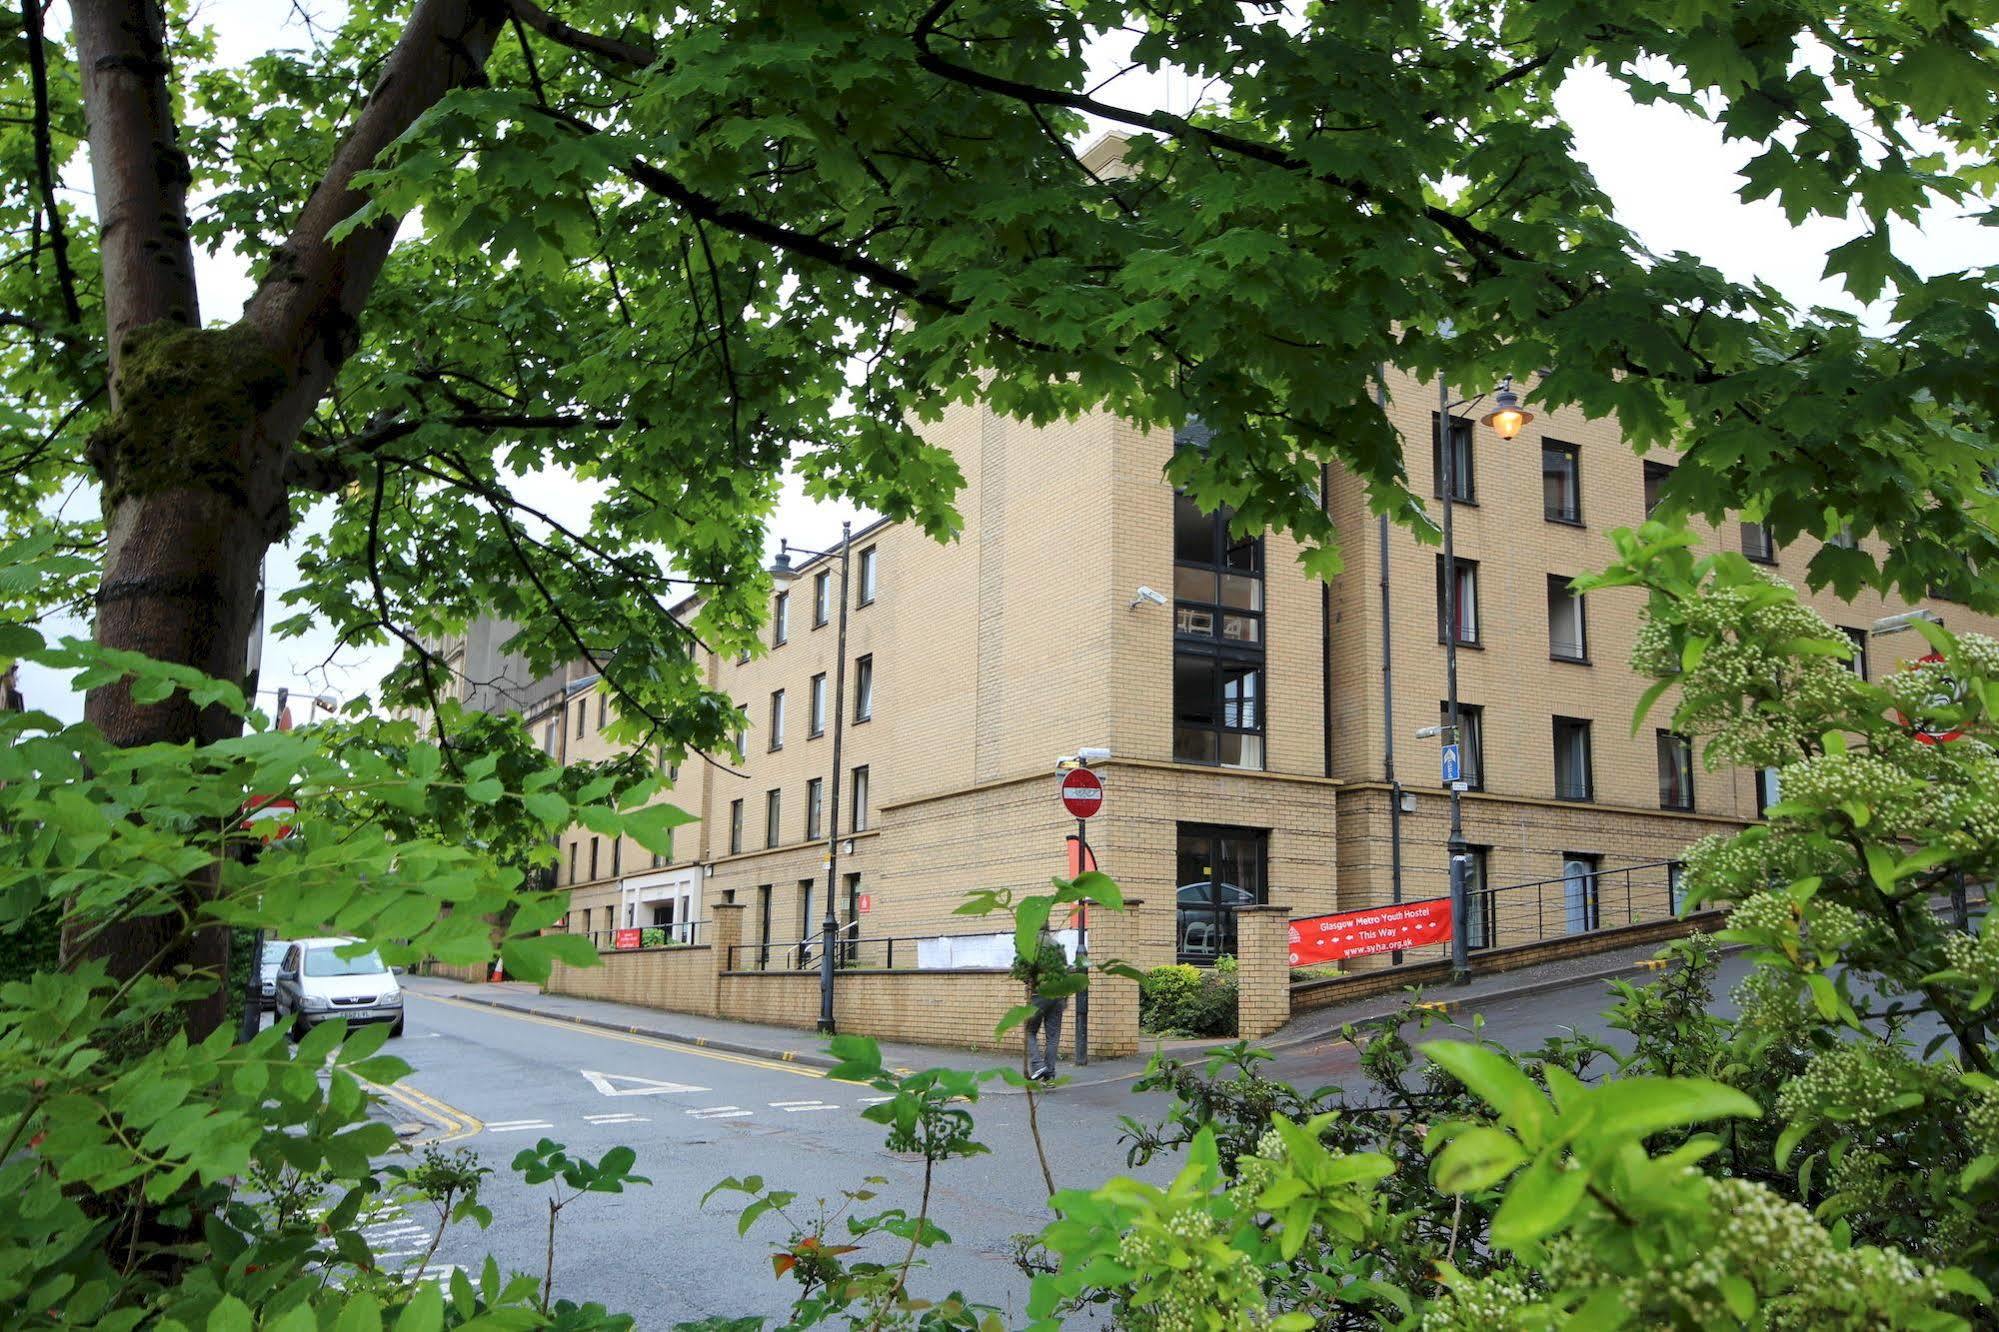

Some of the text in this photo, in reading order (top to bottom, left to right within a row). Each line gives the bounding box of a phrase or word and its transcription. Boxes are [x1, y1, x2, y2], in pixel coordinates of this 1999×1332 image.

[1320, 908, 1430, 932] Glasgow Metro Youth Hostel
[1359, 928, 1396, 939] This Way
[1344, 938, 1413, 956] www.syha.org.uk
